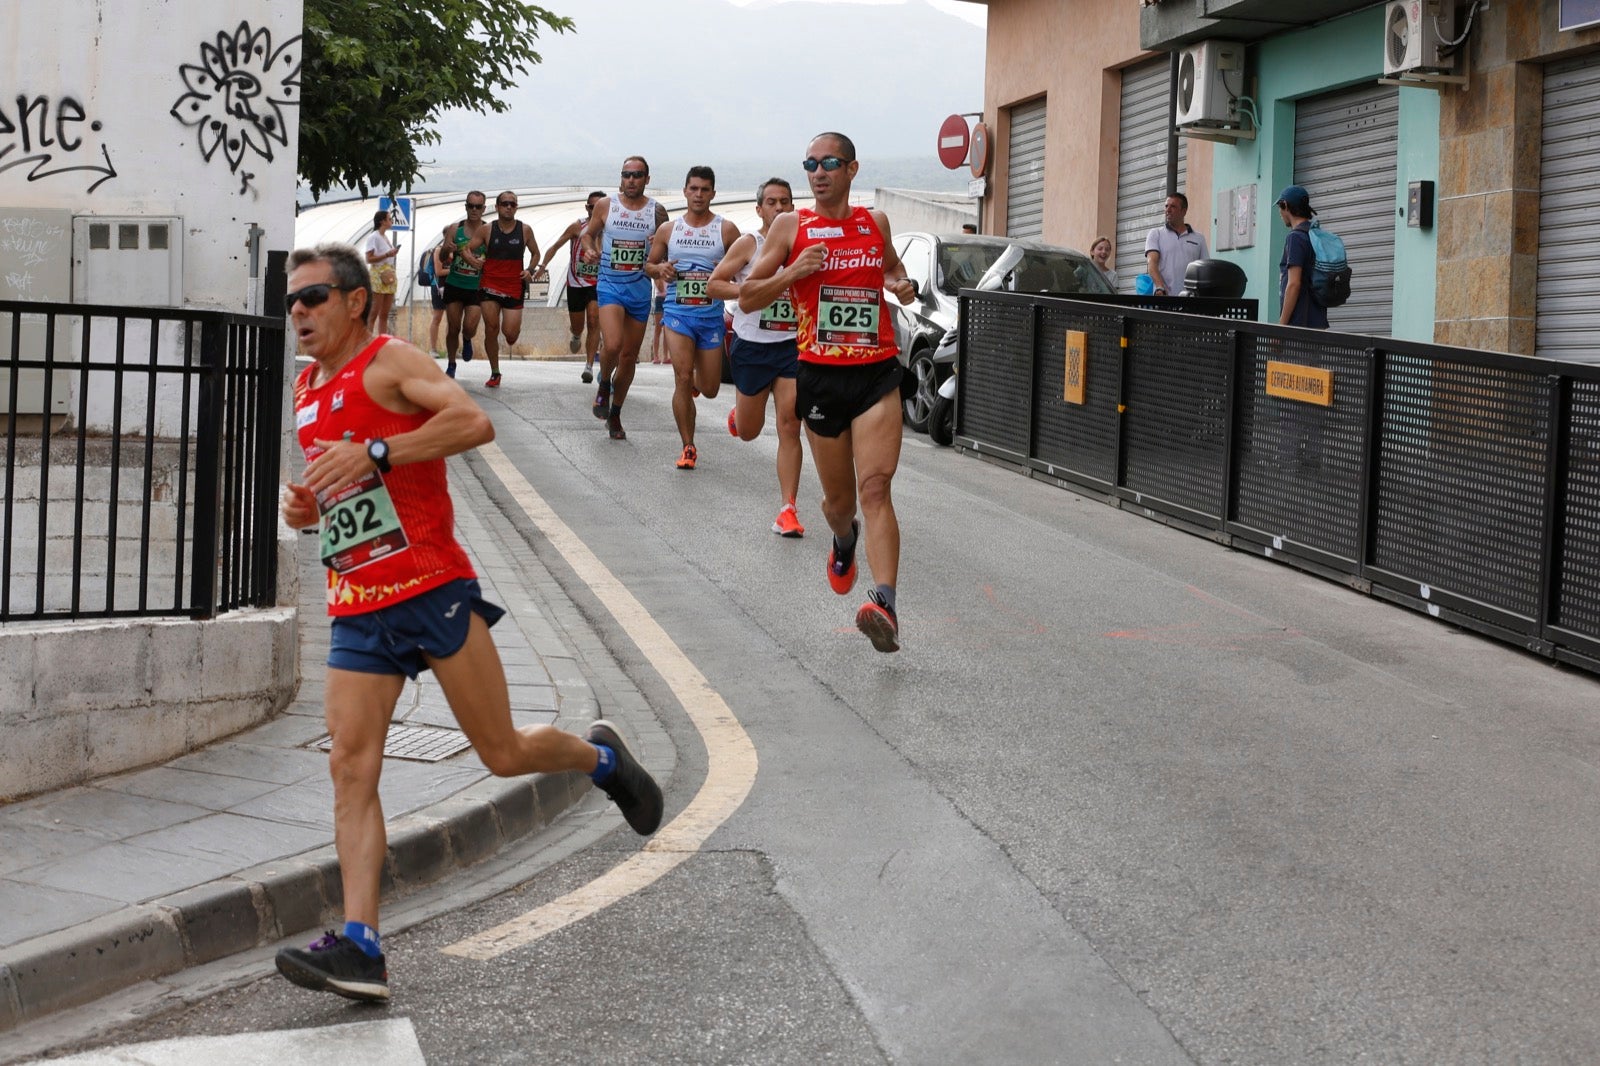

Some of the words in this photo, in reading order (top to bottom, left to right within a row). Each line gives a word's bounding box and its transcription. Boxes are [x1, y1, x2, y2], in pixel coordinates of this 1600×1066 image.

[612, 220, 650, 230] MARACENA
[676, 239, 716, 247] MARACENA
[613, 249, 645, 262] 1073
[819, 254, 883, 271] olisalud
[829, 305, 873, 328] 625
[1271, 371, 1295, 391] CERVEZAS
[1296, 375, 1324, 397] ALHAMBRA
[328, 498, 383, 547] 592
